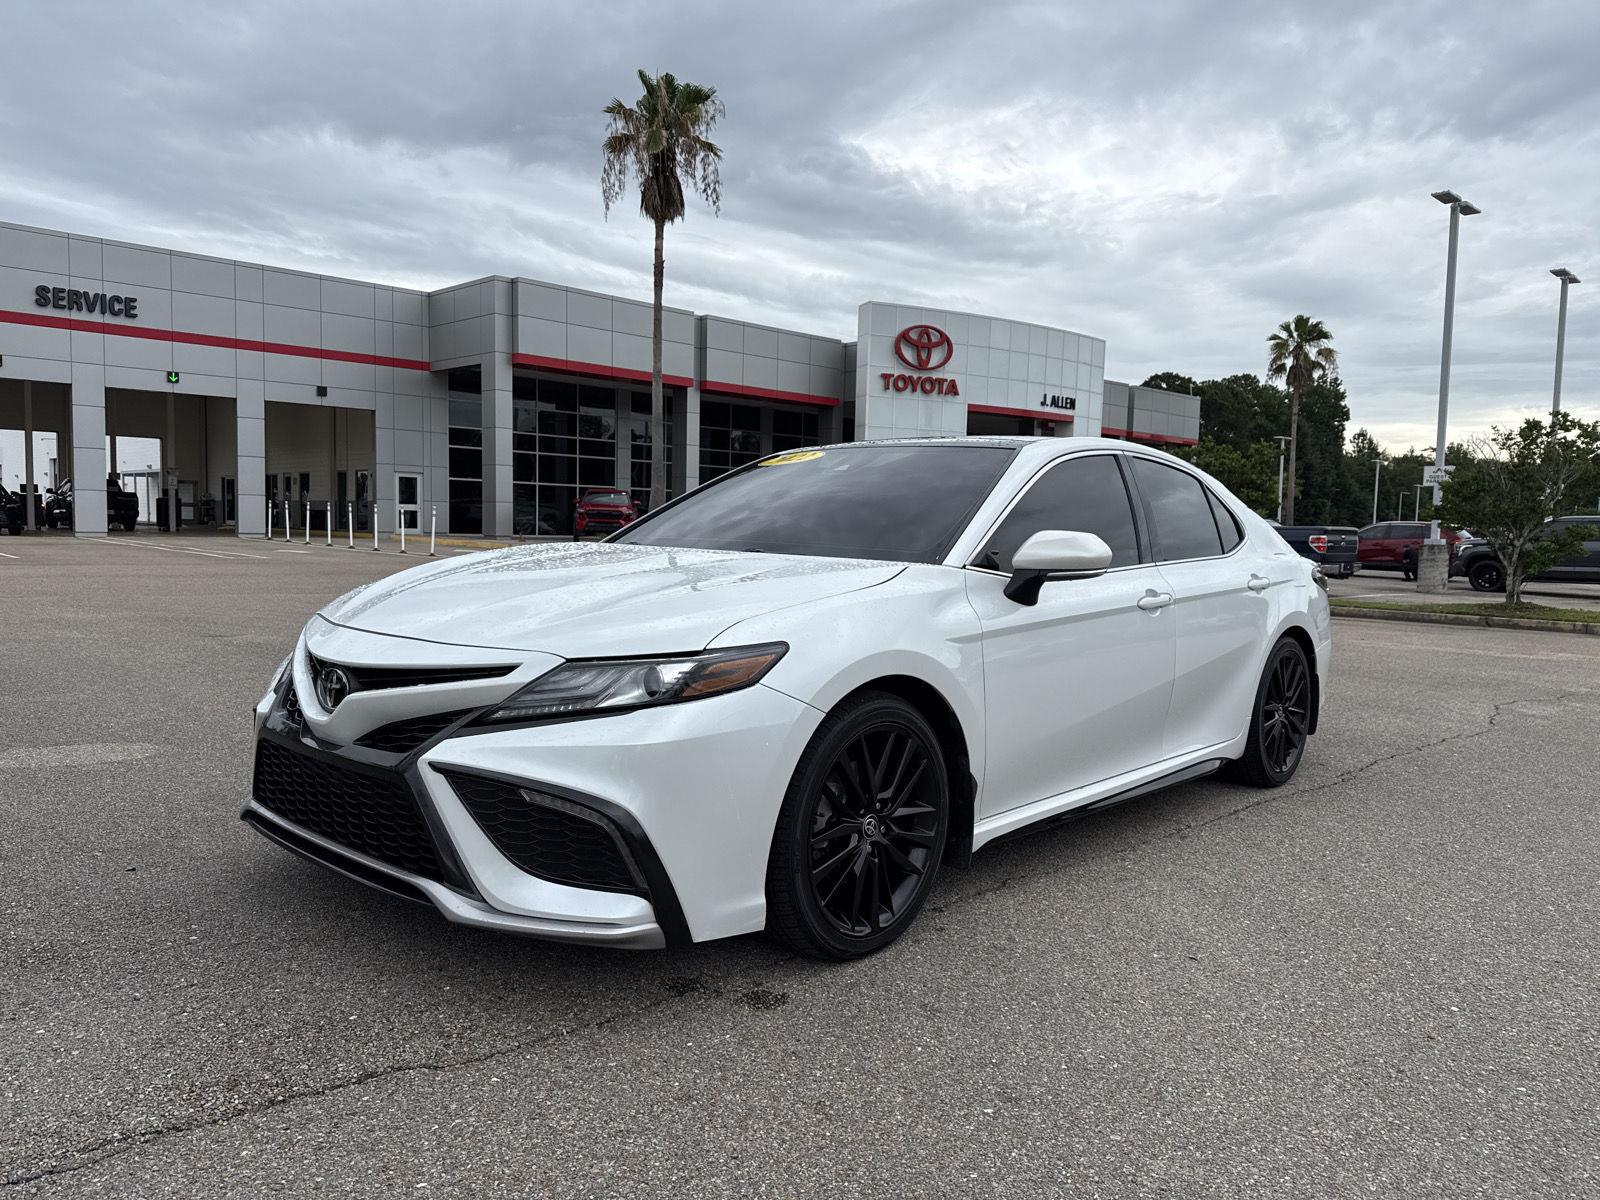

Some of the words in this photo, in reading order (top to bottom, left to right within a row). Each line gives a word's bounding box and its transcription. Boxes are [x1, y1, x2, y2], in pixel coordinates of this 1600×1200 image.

[35, 284, 138, 319] SERVICE
[881, 372, 960, 397] TOYOTA
[1040, 393, 1049, 408] J.
[1050, 395, 1076, 411] ALLEN
